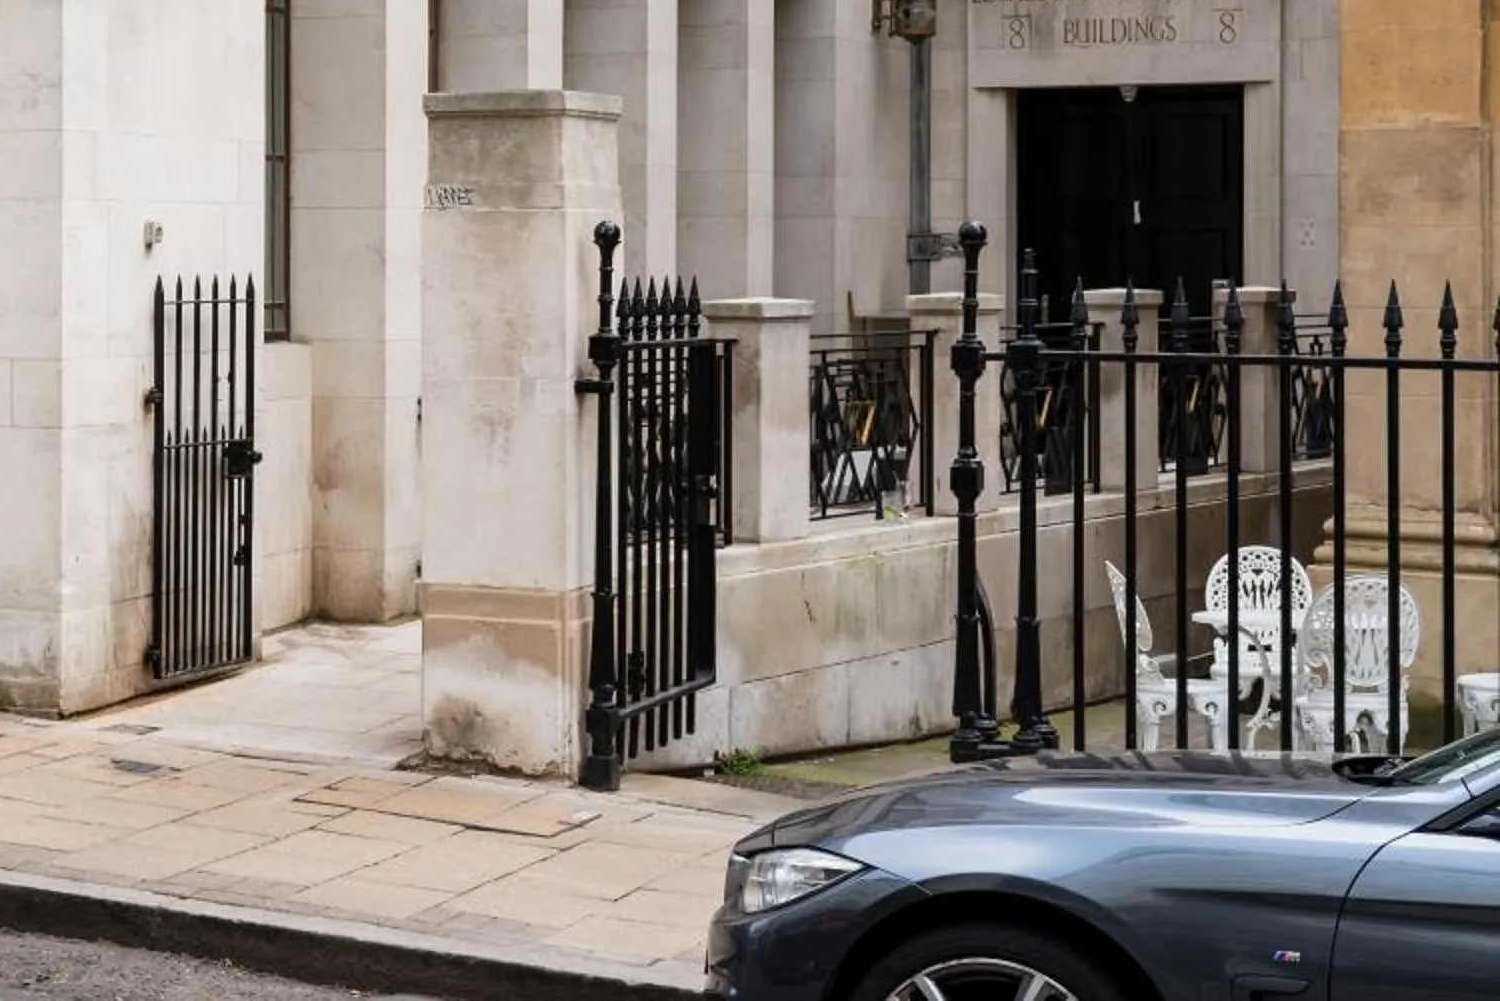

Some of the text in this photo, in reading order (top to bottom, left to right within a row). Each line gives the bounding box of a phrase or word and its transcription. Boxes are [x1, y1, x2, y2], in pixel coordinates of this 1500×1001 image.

[1009, 11, 1237, 49] 8 BUILDINGS 8
